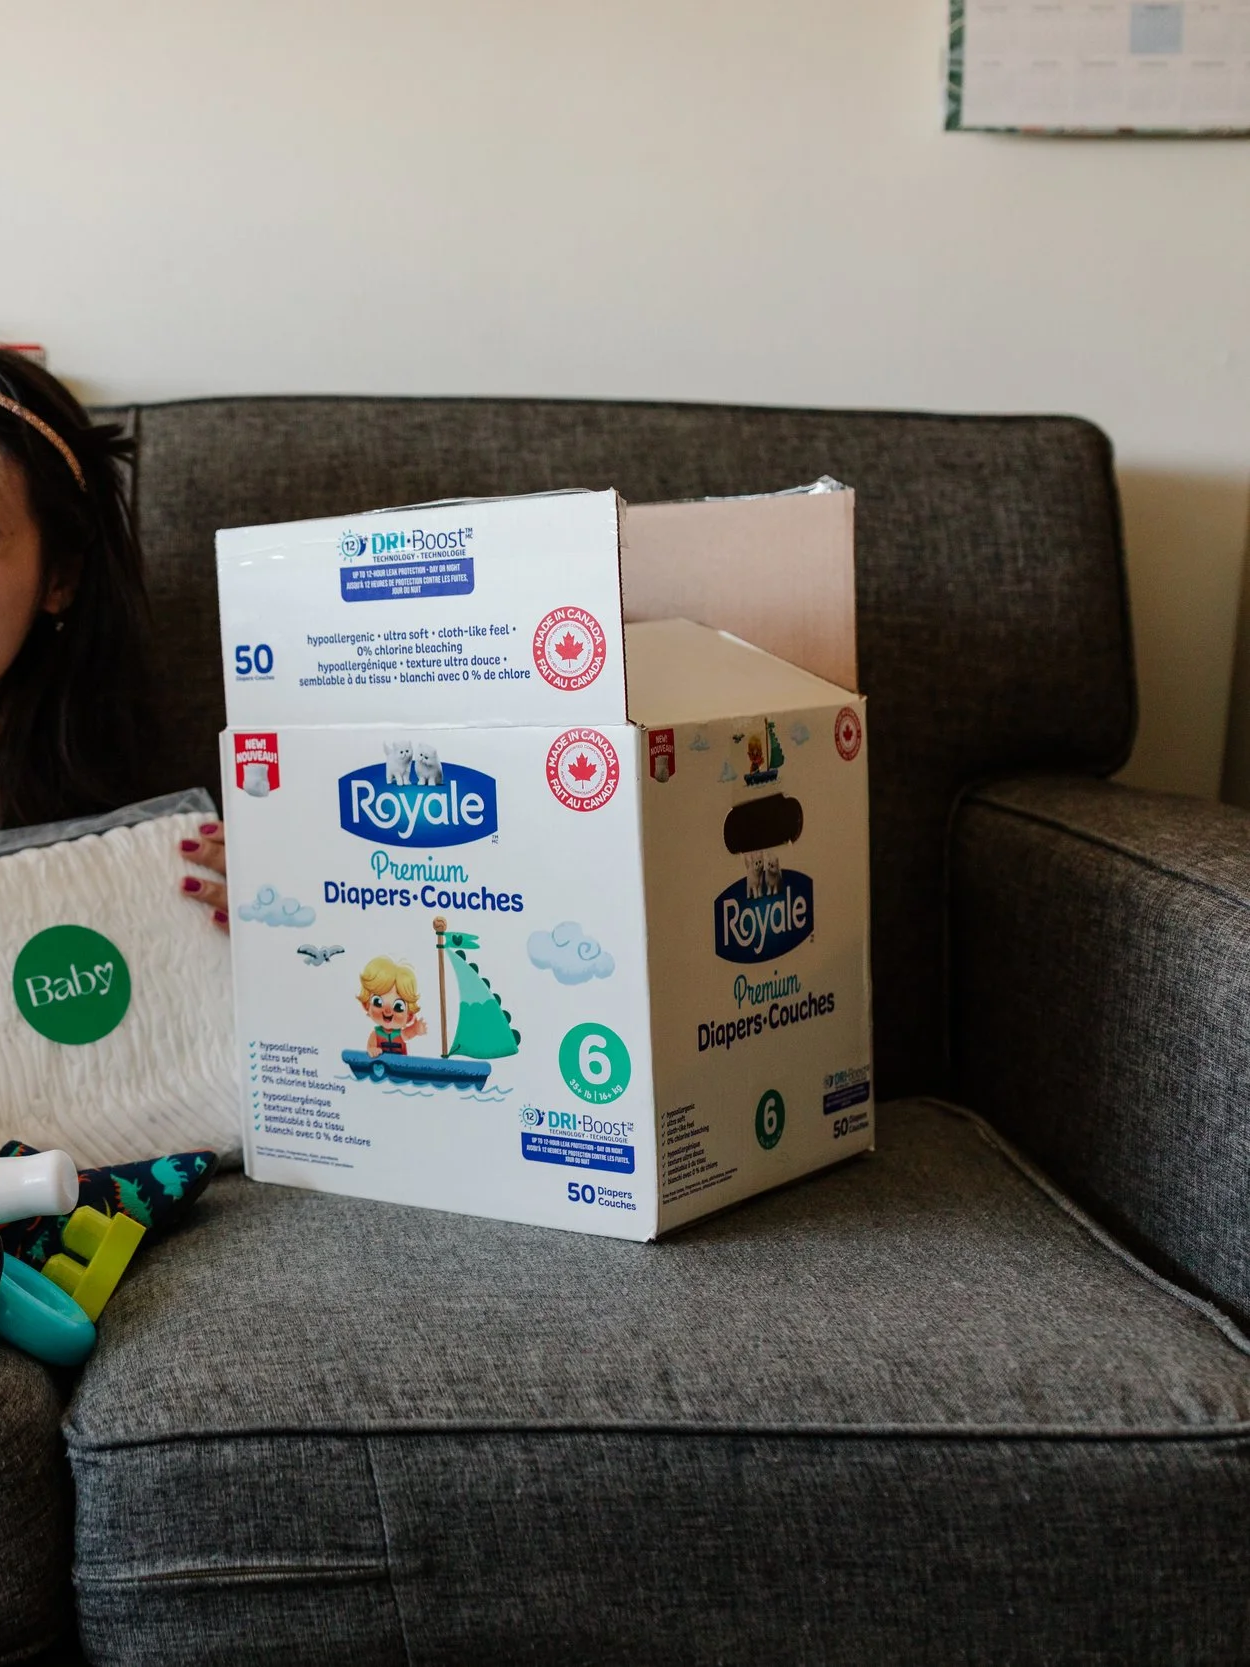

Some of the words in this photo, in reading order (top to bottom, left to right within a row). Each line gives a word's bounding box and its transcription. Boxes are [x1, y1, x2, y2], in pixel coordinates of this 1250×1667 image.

[345, 540, 355, 551] 12
[373, 554, 415, 564] TECHNOLOGY
[421, 549, 466, 559] TECHNOLOGIE
[398, 566, 426, 576] PROTECTION
[446, 564, 461, 572] NIGHT
[396, 577, 422, 586] PROTECTION
[410, 586, 422, 594] NUIT
[307, 632, 375, 647] hypoallergenic
[383, 630, 406, 641] ultra
[409, 628, 429, 640] soft
[438, 625, 488, 639] cloth-like
[489, 624, 510, 636] feel
[535, 616, 555, 648] MADE
[554, 610, 566, 621] IN
[567, 608, 604, 645] CANADA
[357, 646, 373, 656] 0%
[374, 644, 413, 656] chlorine
[416, 642, 463, 655] bleaching
[235, 644, 274, 675] 50
[318, 658, 398, 674] hypoallergénique
[406, 657, 442, 669] texture
[444, 656, 468, 668] ultra
[470, 655, 501, 666] douce
[299, 675, 345, 687] semblable
[347, 674, 353, 685] à
[355, 674, 367, 684] du
[368, 674, 392, 684] tissu
[400, 672, 436, 683] blanchi
[437, 672, 460, 682] avec
[462, 670, 470, 682] 0
[471, 670, 482, 681] %
[484, 669, 496, 680] de
[499, 668, 531, 680] chlore
[537, 658, 555, 681] FAIT
[553, 677, 568, 688] AU
[570, 656, 604, 688] CANADA
[244, 738, 266, 750] NEW!
[548, 736, 569, 768] MADE
[568, 731, 580, 742] IN
[581, 730, 616, 768] CANADA
[236, 750, 278, 764] NOUVEAU!
[550, 778, 569, 801] FAIT
[566, 797, 581, 809] AU
[583, 778, 616, 810] CANADA
[351, 779, 485, 840] Royale
[371, 850, 469, 883] Premium
[723, 885, 807, 955] Royale
[25, 961, 114, 1008] Baby
[734, 970, 801, 1009] Premium
[260, 1041, 319, 1056] hypoallergenic
[260, 1053, 280, 1062] ultra
[282, 1055, 298, 1064] soft
[579, 1034, 612, 1085] 6
[261, 1064, 300, 1076] cloth-like
[302, 1067, 319, 1078] feel
[262, 1074, 274, 1084] 0%
[276, 1076, 306, 1088] chlorine
[308, 1080, 346, 1094] bleaching
[570, 1079, 582, 1094] 35+
[584, 1090, 592, 1100] lb
[612, 1084, 624, 1095] kg
[264, 1103, 292, 1114] texture
[294, 1106, 315, 1116] ultra
[316, 1108, 341, 1120] douce
[525, 1112, 534, 1121] 12
[764, 1098, 778, 1136] 6
[264, 1114, 304, 1127] semblable
[312, 1120, 323, 1129] du
[324, 1121, 344, 1132] tissu
[834, 1116, 848, 1140] 50
[265, 1124, 294, 1136] blanchi
[295, 1130, 314, 1140] avec
[332, 1134, 343, 1143] de
[344, 1136, 372, 1147] chlore
[550, 1128, 585, 1139] TECHNOLOGY
[590, 1134, 628, 1144] TECHNOLOGIE
[568, 1182, 596, 1204] 50
[598, 1186, 633, 1200] Diapers
[598, 1197, 636, 1211] Couches
